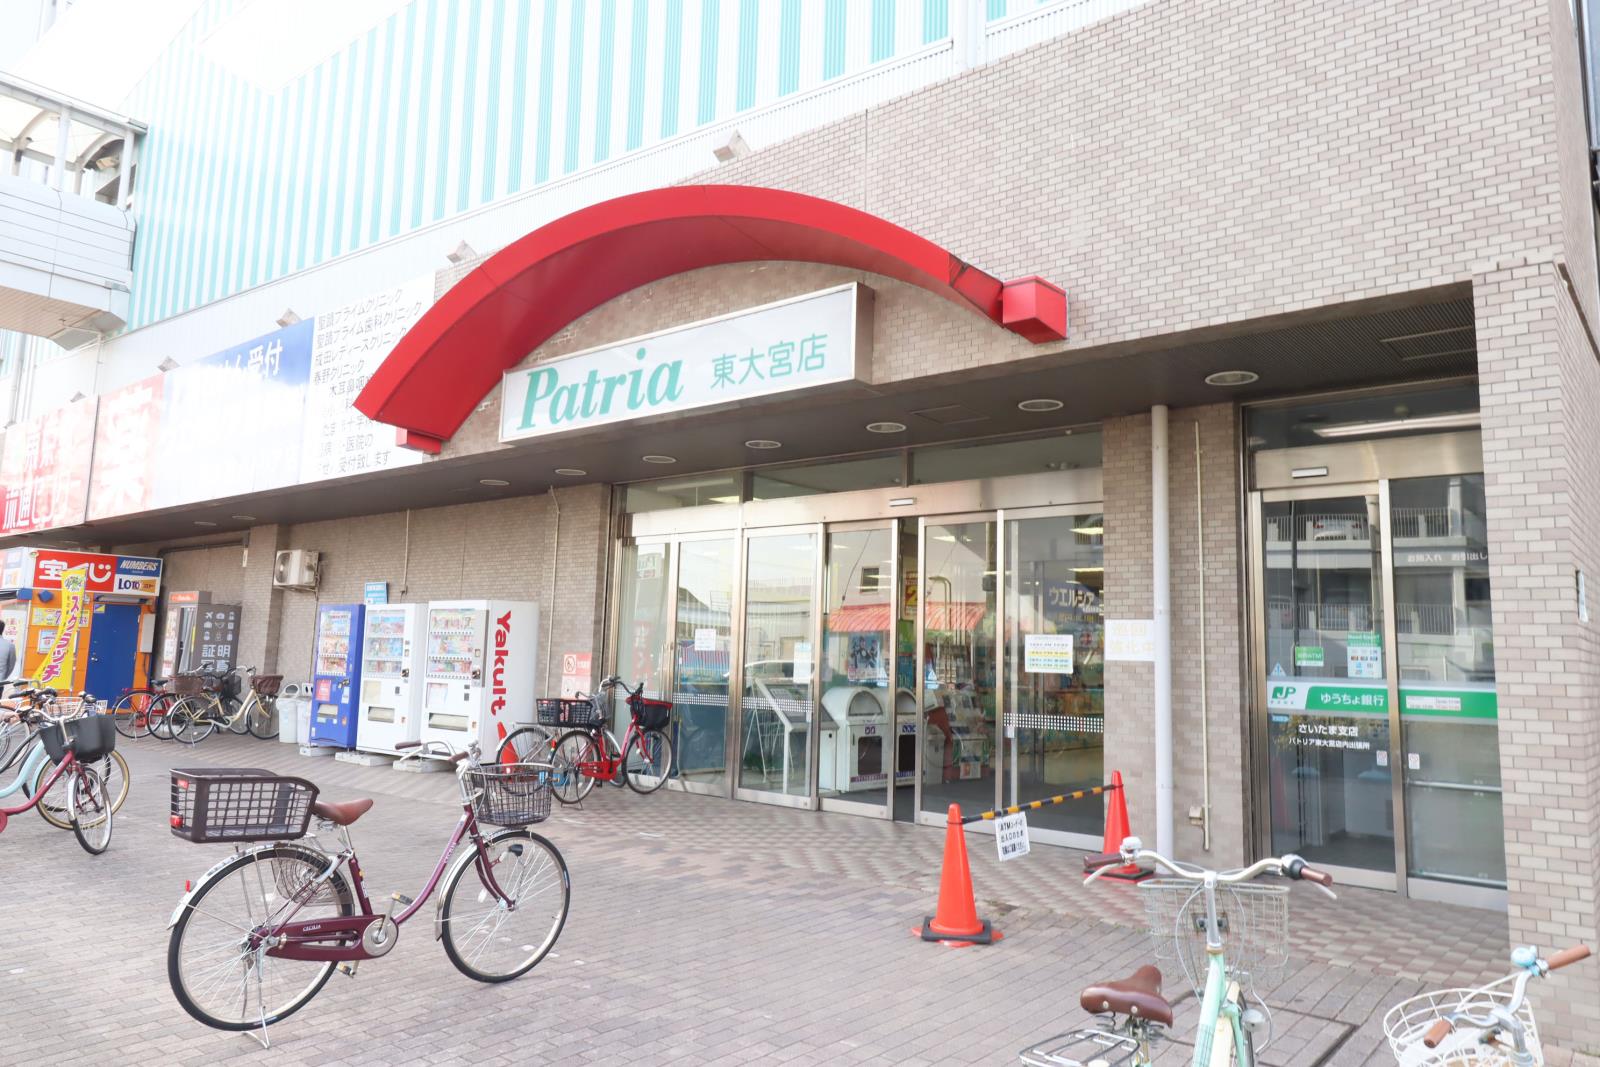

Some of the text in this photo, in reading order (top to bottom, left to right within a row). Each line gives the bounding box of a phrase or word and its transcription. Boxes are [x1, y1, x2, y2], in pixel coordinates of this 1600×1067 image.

[516, 332, 829, 431] Patria 東大宮店
[38, 560, 111, 583] 宝じ
[42, 595, 80, 682] スクラッチ
[202, 644, 231, 658] 証明
[490, 610, 512, 716] Yakult
[1271, 686, 1297, 699] JP
[1320, 691, 1385, 707] ゆうちょ銀行
[1297, 723, 1359, 737] さいたま支店
